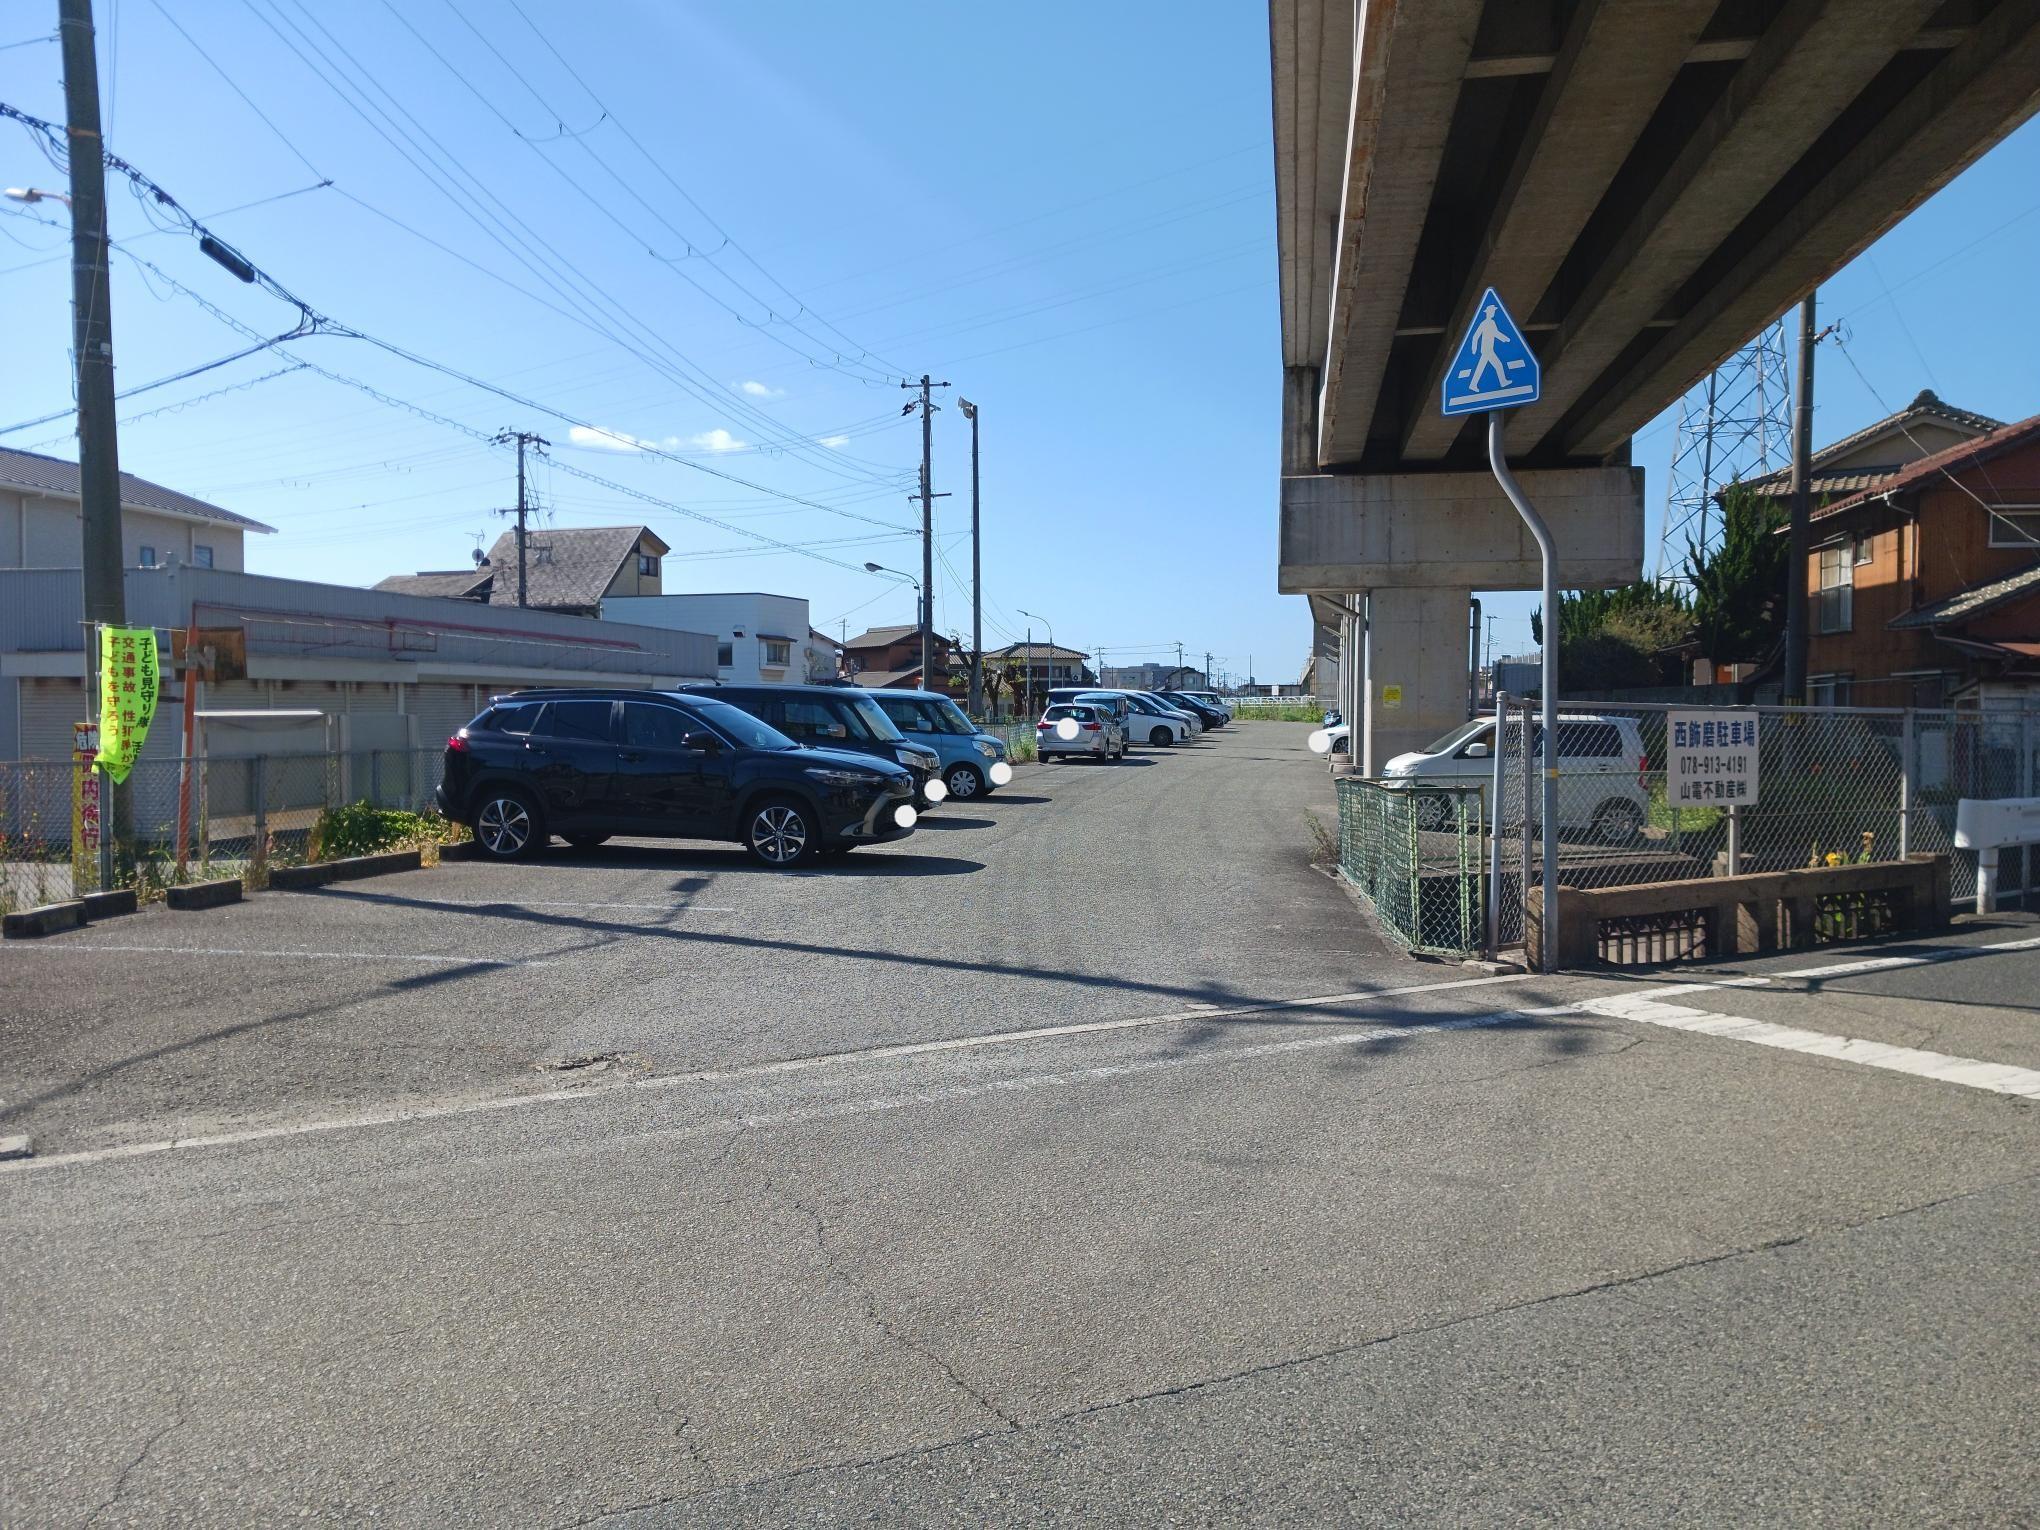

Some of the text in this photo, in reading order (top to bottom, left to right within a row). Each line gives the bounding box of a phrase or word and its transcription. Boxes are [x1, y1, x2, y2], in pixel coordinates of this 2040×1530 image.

[75, 730, 98, 751] 危険
[1674, 720, 1755, 747] 西飾磨駐車場
[1680, 756, 1747, 774] 078-913-4191
